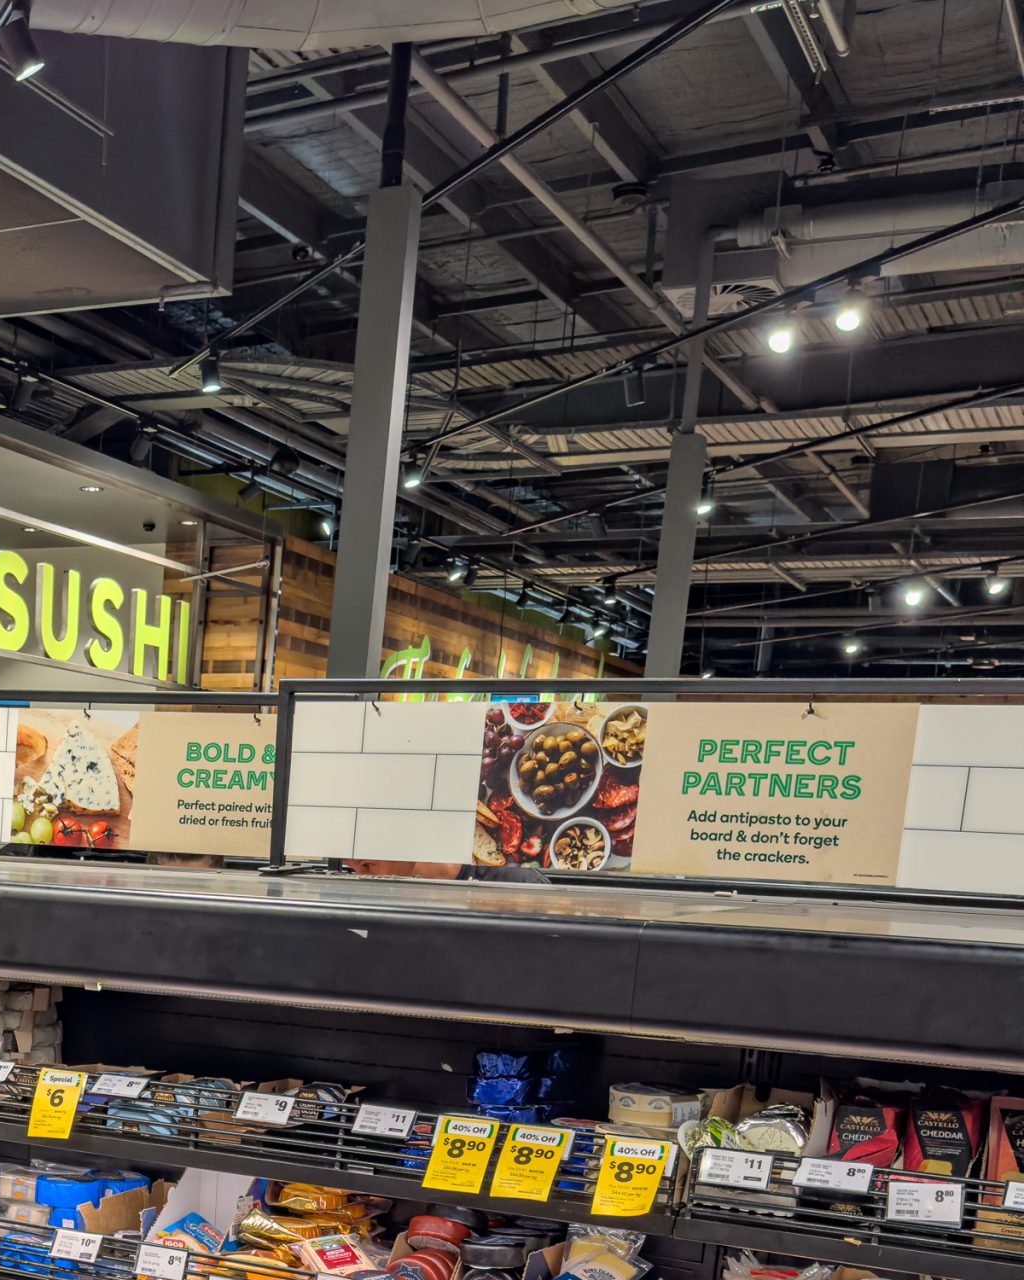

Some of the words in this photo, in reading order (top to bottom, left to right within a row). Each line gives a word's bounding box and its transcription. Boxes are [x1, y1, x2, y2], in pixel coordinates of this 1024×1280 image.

[186, 742, 257, 764] BOLD
[697, 739, 855, 766] PERFECT
[681, 771, 862, 800] PARTNERS
[177, 799, 215, 811] Perfect
[218, 801, 254, 815] paired
[256, 802, 273, 813] wit
[179, 815, 204, 827] dried
[207, 818, 219, 827] or
[221, 816, 248, 829] fresh
[687, 810, 717, 823] Add
[720, 812, 791, 827] antipasto
[795, 815, 810, 827] to
[813, 816, 848, 830] your
[690, 829, 733, 842] board
[736, 831, 747, 843] &
[750, 831, 790, 845] don't
[793, 832, 840, 849] forget
[716, 848, 741, 861] the
[744, 850, 810, 865] crackers.
[49, 1076, 73, 1084] Special
[46, 1088, 65, 1108] $6
[275, 1099, 288, 1112] $9
[392, 1113, 407, 1123] $11
[917, 1120, 960, 1129] CASTELLO
[452, 1124, 471, 1134] 40%
[472, 1126, 487, 1135] Off
[840, 1123, 881, 1132] CASTELLO
[519, 1132, 539, 1142] 40%
[541, 1135, 557, 1144] Off
[842, 1132, 873, 1141] CHEDD
[920, 1129, 964, 1140] CHEDDAR
[617, 1146, 639, 1155] 40%
[640, 1148, 656, 1157] Off
[745, 1158, 763, 1170] $11
[934, 1190, 955, 1203] 880
